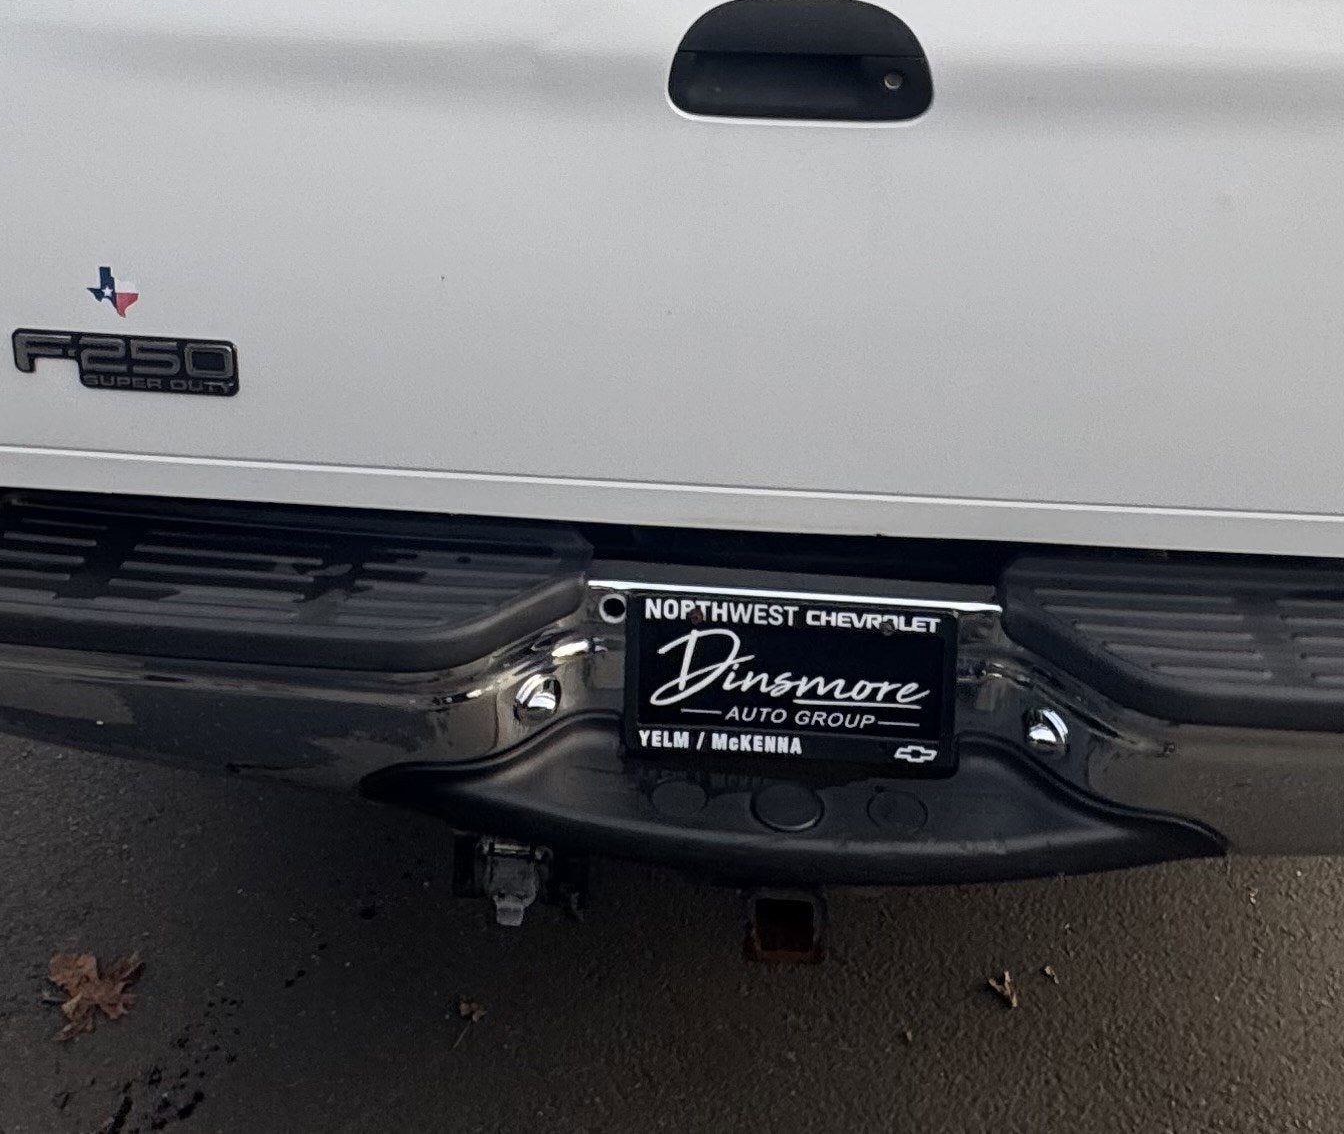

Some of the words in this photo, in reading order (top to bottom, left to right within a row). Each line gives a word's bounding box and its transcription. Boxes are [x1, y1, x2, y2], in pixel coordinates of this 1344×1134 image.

[83, 374, 163, 391] SUPER
[170, 378, 233, 394] DUTY
[644, 598, 799, 627] NORTHWEST
[649, 628, 931, 707] Dinsmore
[724, 705, 788, 725] AUTO
[794, 709, 877, 730] GROUP
[638, 730, 690, 750] YELM
[696, 731, 706, 751] /
[711, 732, 803, 755] McKENNA
